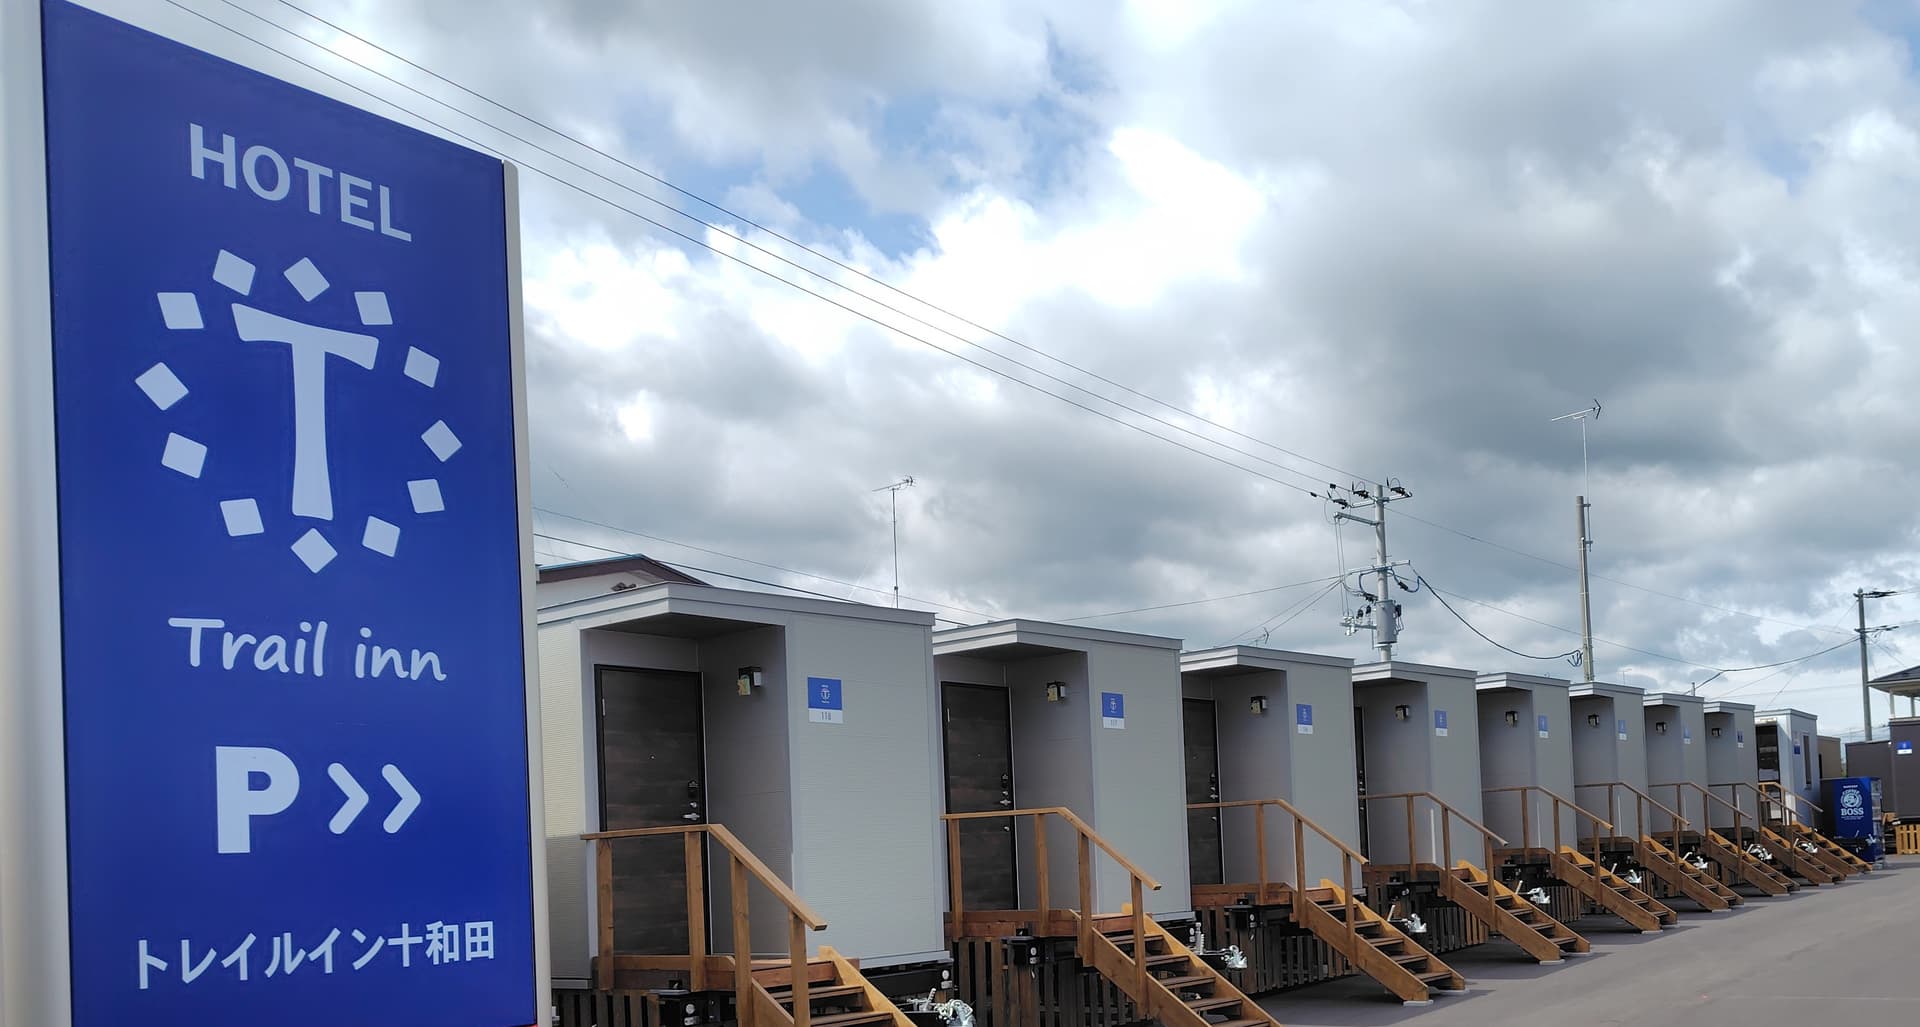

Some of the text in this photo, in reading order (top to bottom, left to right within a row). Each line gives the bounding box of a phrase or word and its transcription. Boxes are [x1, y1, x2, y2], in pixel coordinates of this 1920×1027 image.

[190, 122, 412, 242] HOTEL
[231, 303, 379, 521] T
[168, 617, 447, 681] Trail inn
[215, 745, 300, 854] P
[1840, 807, 1864, 816] BOSS
[138, 920, 495, 990] トレイルイン十和田
